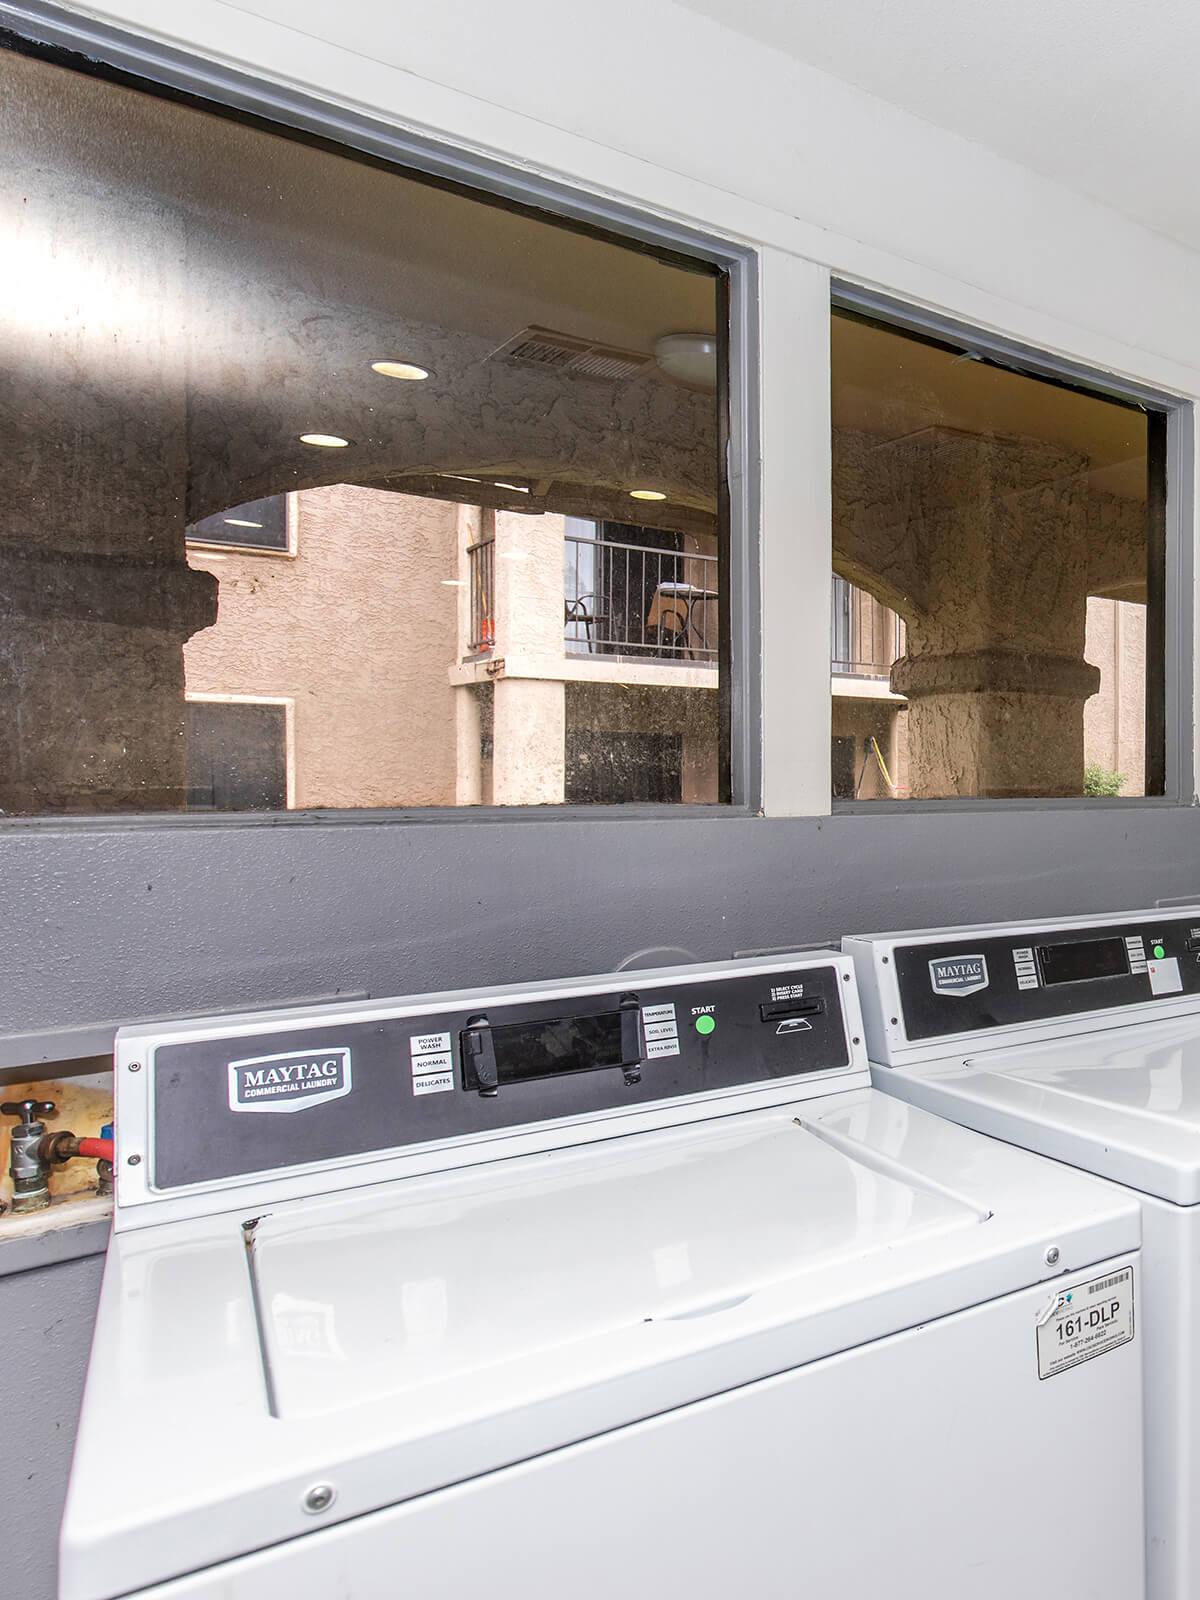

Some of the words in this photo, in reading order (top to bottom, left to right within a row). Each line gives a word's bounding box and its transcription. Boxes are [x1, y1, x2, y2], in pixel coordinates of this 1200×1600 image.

[937, 963, 981, 978] MAYTAG
[691, 1005, 716, 1015] START
[418, 1036, 443, 1044] POWER
[416, 1058, 447, 1068] NORMAL
[244, 1060, 338, 1088] MAYTAG
[244, 1083, 300, 1098] COMMERCIAL
[301, 1077, 338, 1090] LAUNDRY
[416, 1077, 451, 1088] DELICATES
[1056, 1301, 1120, 1340] 161-DLP
